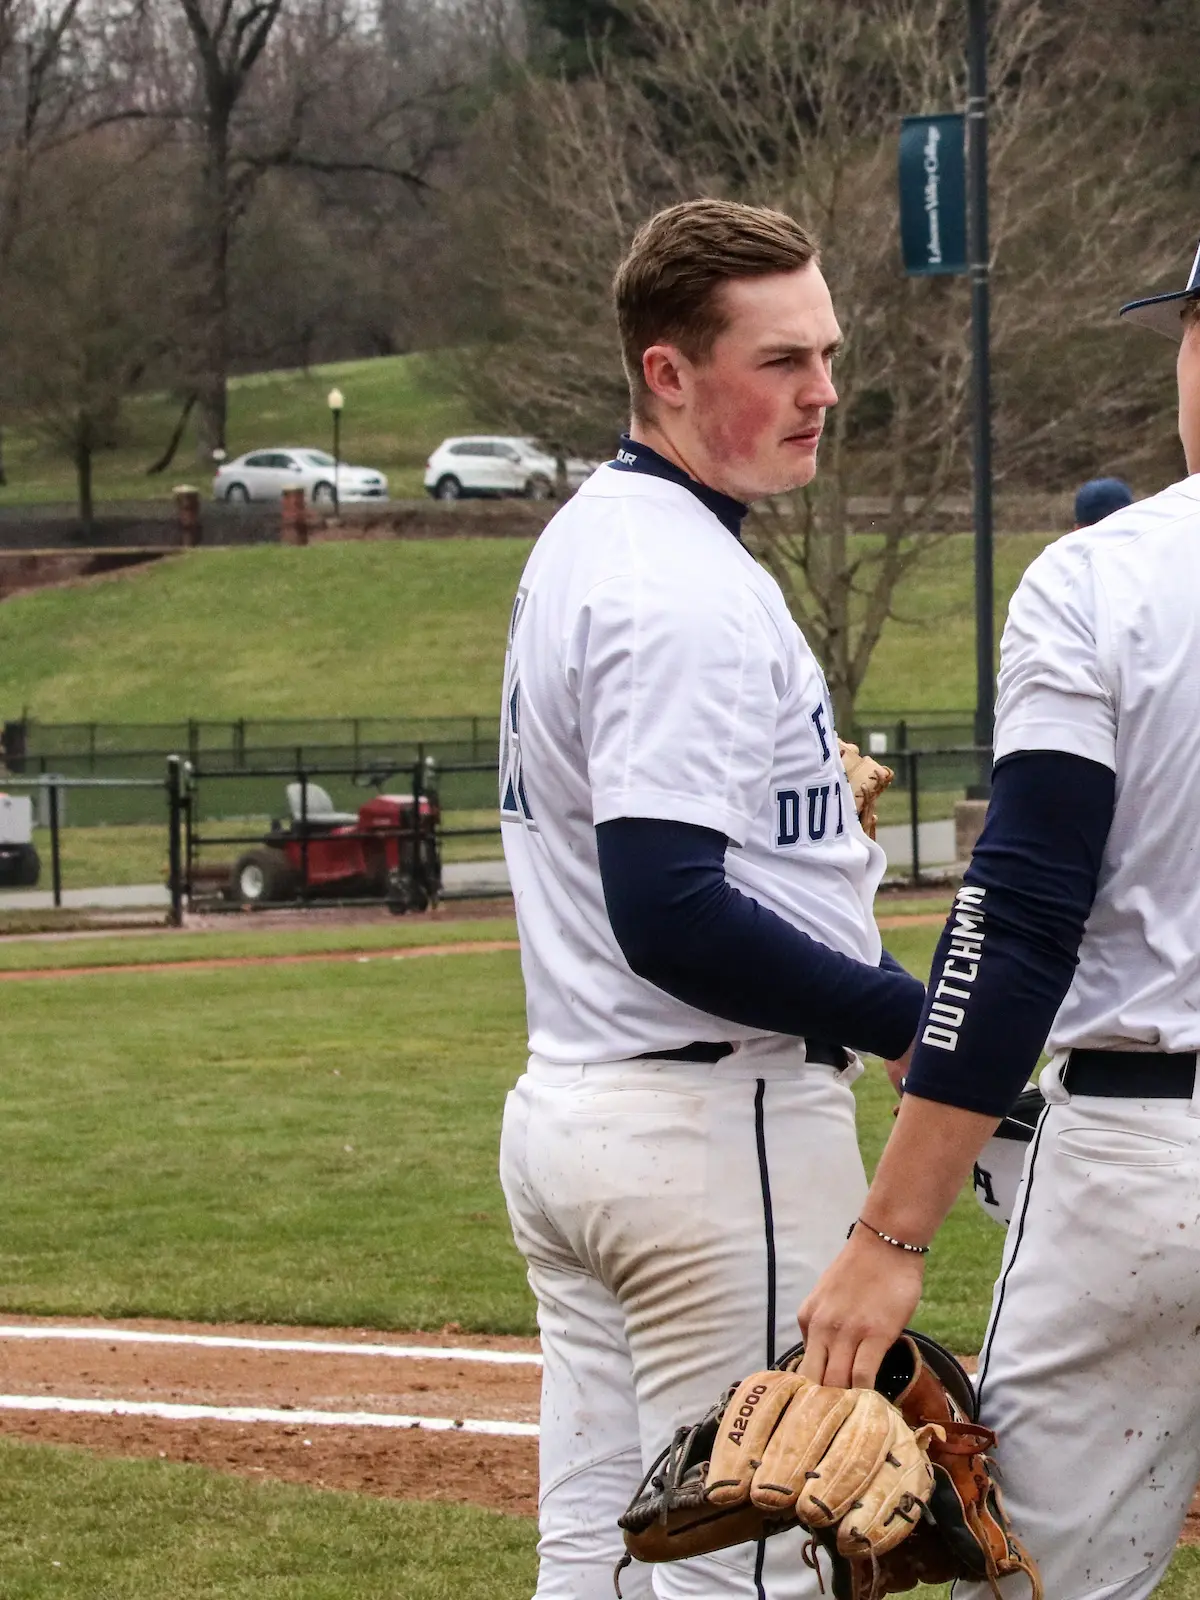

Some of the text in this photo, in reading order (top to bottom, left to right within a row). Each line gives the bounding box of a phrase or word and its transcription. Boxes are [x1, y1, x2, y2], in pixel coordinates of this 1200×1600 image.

[924, 125, 941, 173] College
[924, 175, 940, 211] Valley
[727, 1384, 768, 1447] A2000
